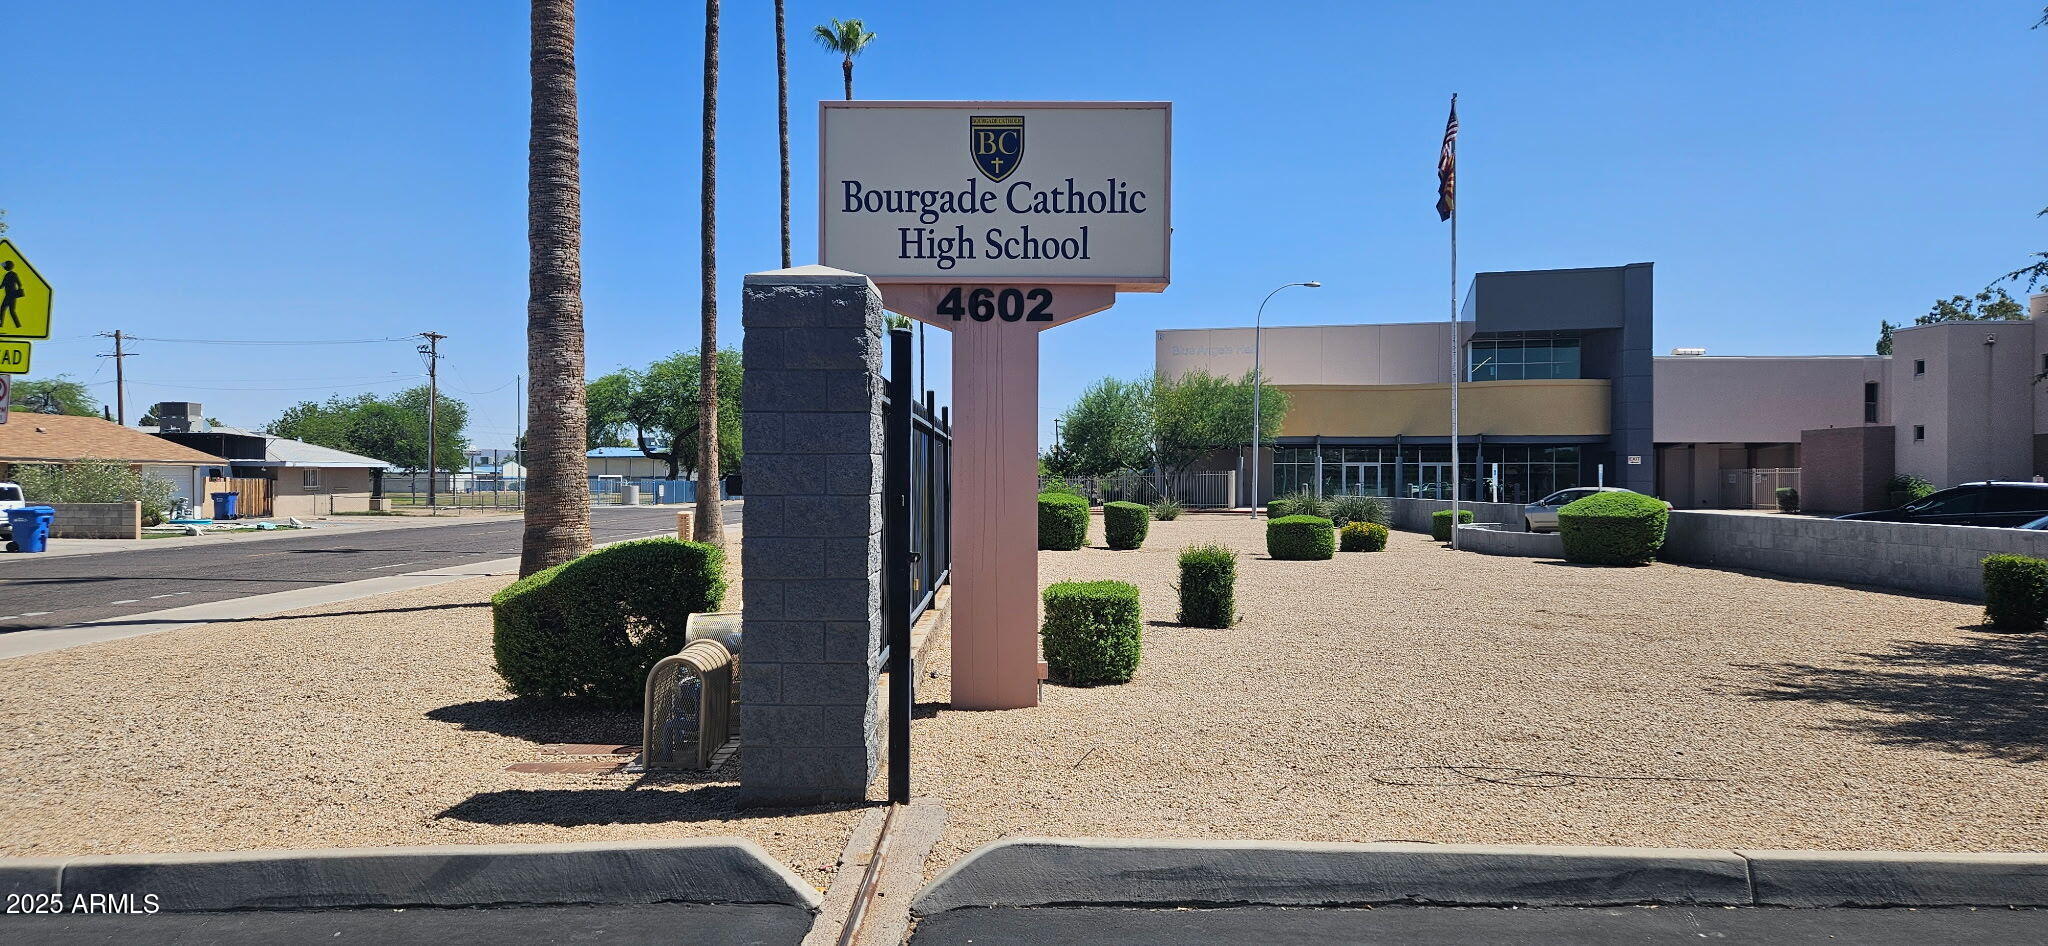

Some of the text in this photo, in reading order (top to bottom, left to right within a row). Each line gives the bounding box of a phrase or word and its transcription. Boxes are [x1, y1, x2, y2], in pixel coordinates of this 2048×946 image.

[977, 131, 1018, 154] BC
[841, 178, 1147, 224] Bourgade Catholic
[897, 225, 1091, 270] High School
[936, 287, 1054, 322] 4602
